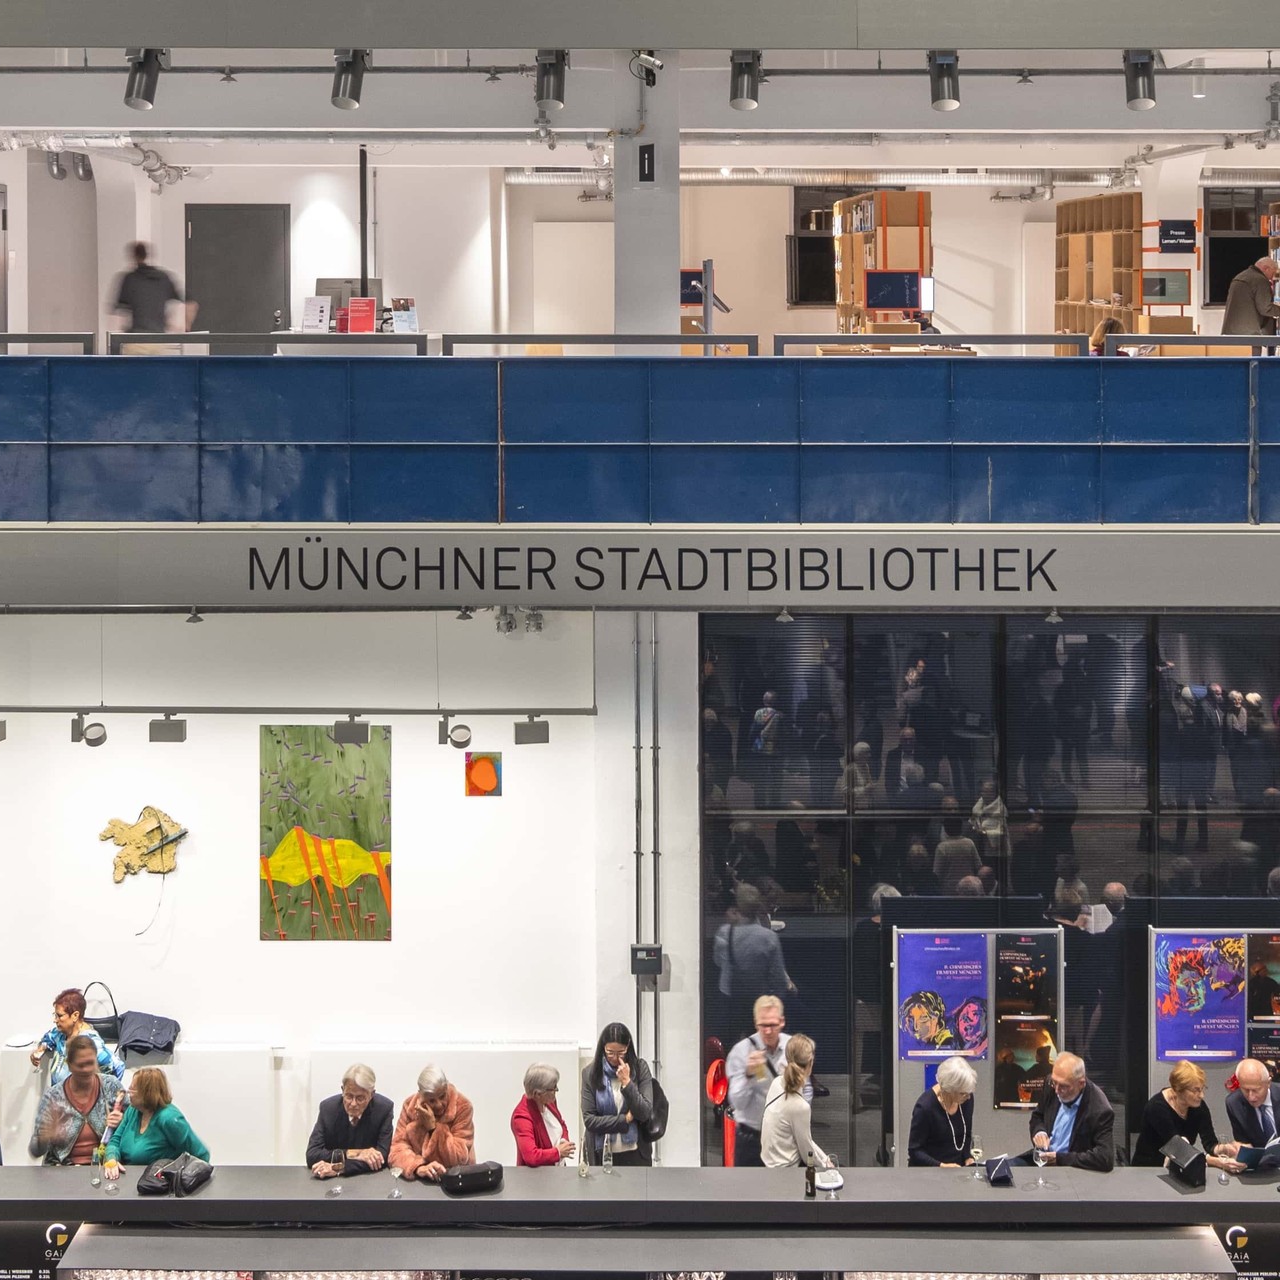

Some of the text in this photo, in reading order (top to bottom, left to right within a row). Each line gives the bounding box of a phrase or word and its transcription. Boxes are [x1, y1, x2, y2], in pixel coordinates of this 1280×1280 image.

[248, 537, 1059, 592] MÜNCHNER STADTBIBLIOTHEK
[45, 1249, 63, 1257] GAi
